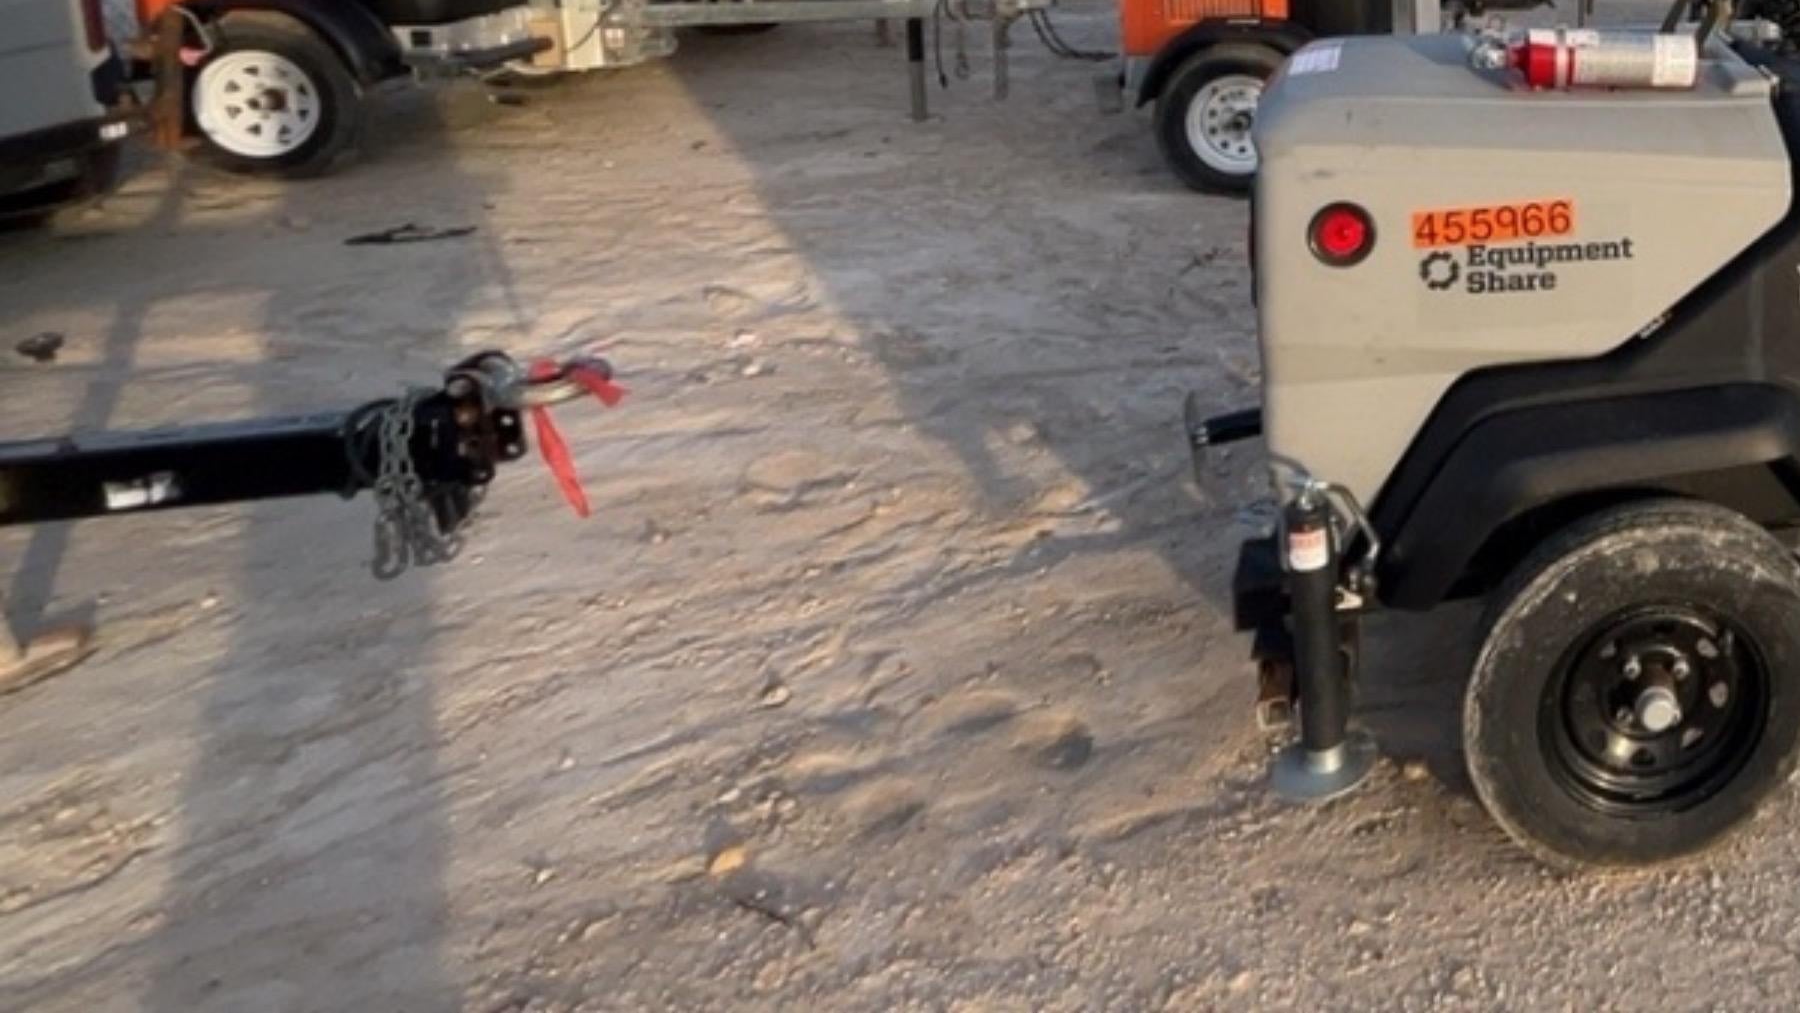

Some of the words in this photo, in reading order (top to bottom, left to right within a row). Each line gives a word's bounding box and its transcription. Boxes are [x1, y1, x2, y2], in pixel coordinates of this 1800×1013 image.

[1415, 200, 1572, 246] 455966
[1466, 237, 1634, 271] Equipment
[1466, 270, 1557, 294] Share
